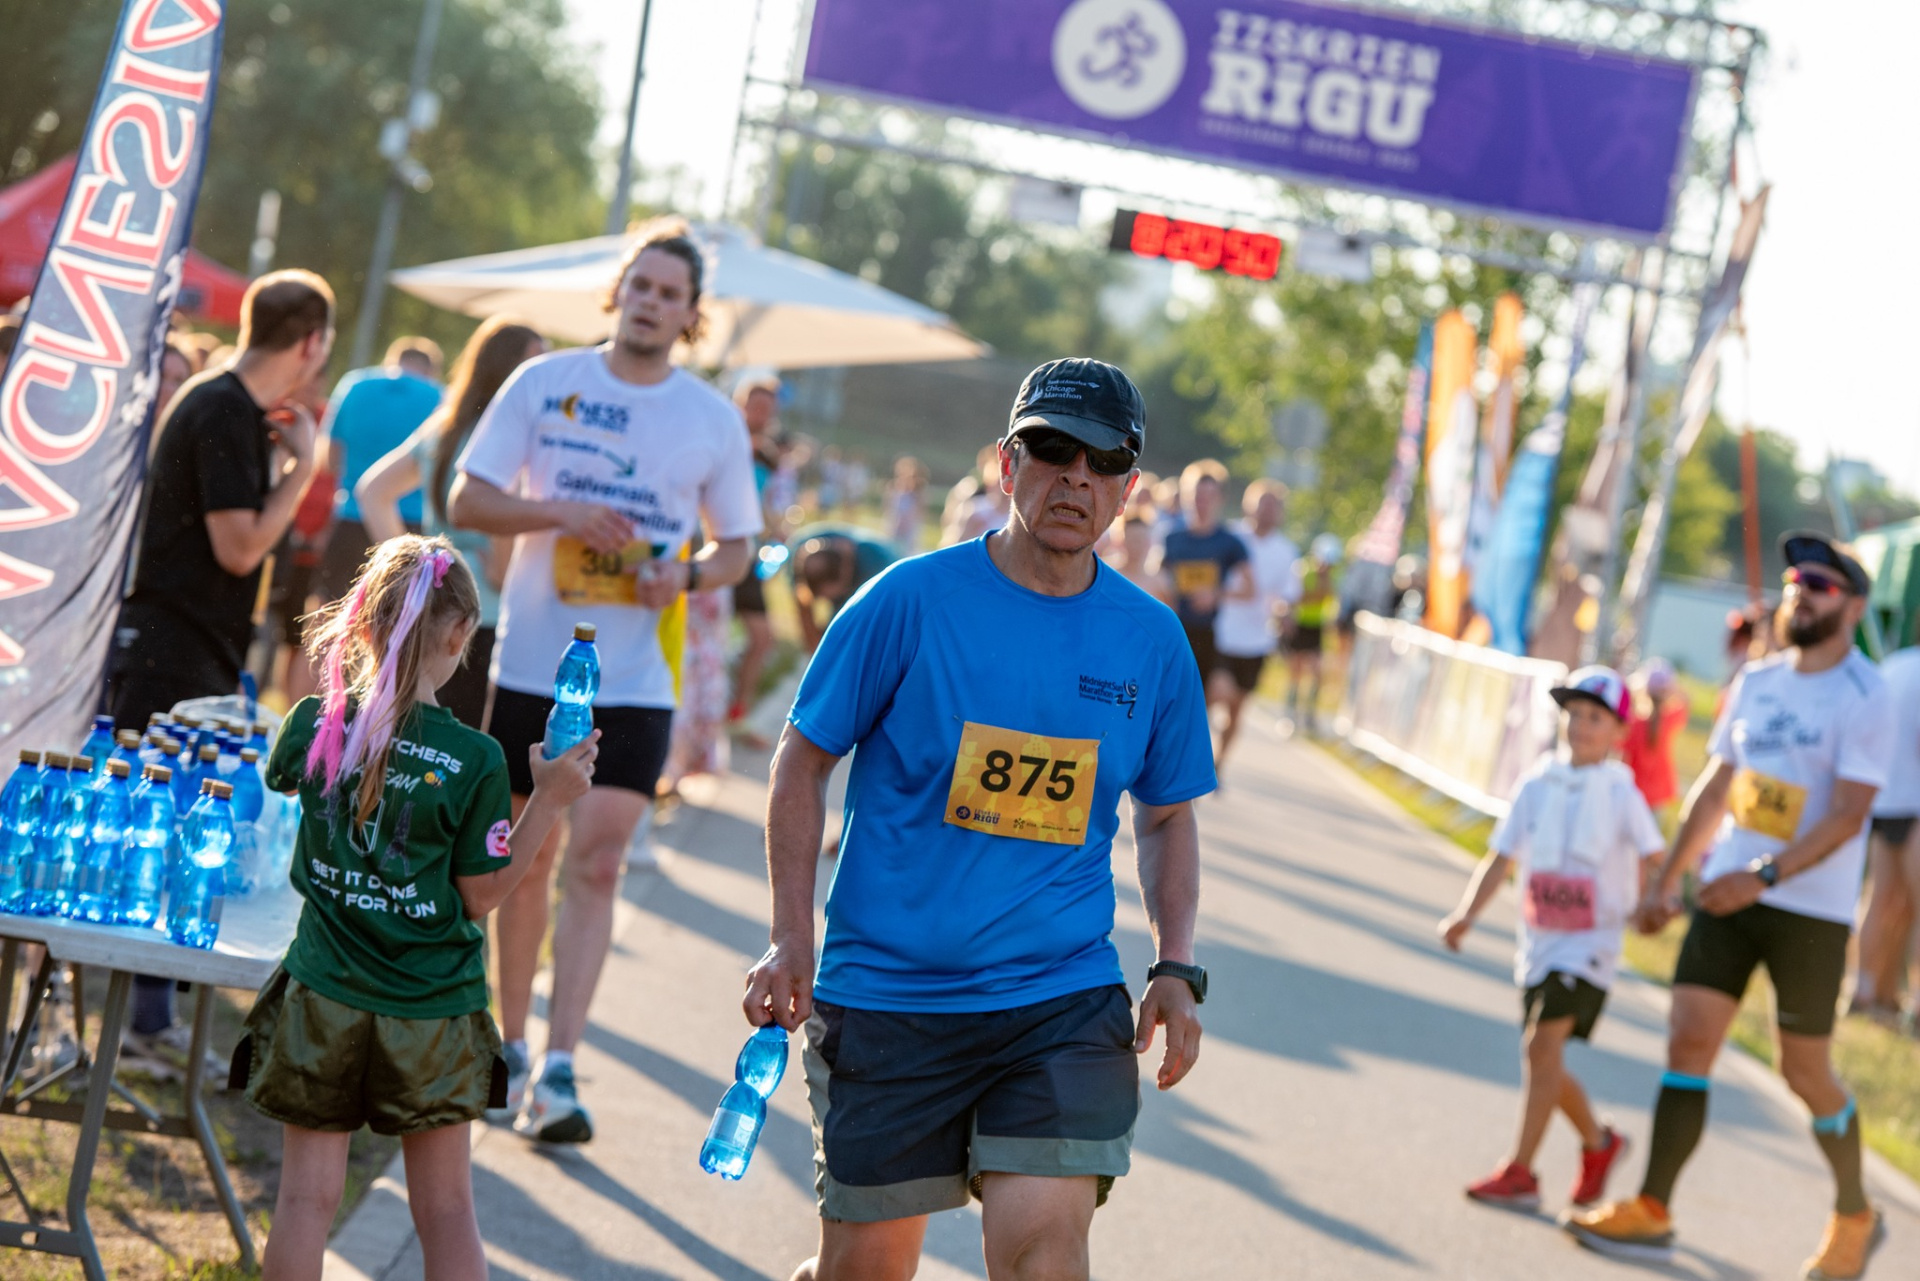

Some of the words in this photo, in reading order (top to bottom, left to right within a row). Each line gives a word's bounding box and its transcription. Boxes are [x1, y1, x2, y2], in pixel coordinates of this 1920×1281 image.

[1045, 385, 1076, 393] Chicago
[1079, 683, 1114, 699] Marathon
[390, 736, 463, 774] TCHERS
[385, 767, 422, 795] EAM
[980, 749, 1077, 802] 875
[312, 858, 339, 881] GET
[345, 870, 363, 886] IT
[345, 892, 388, 912] FOR
